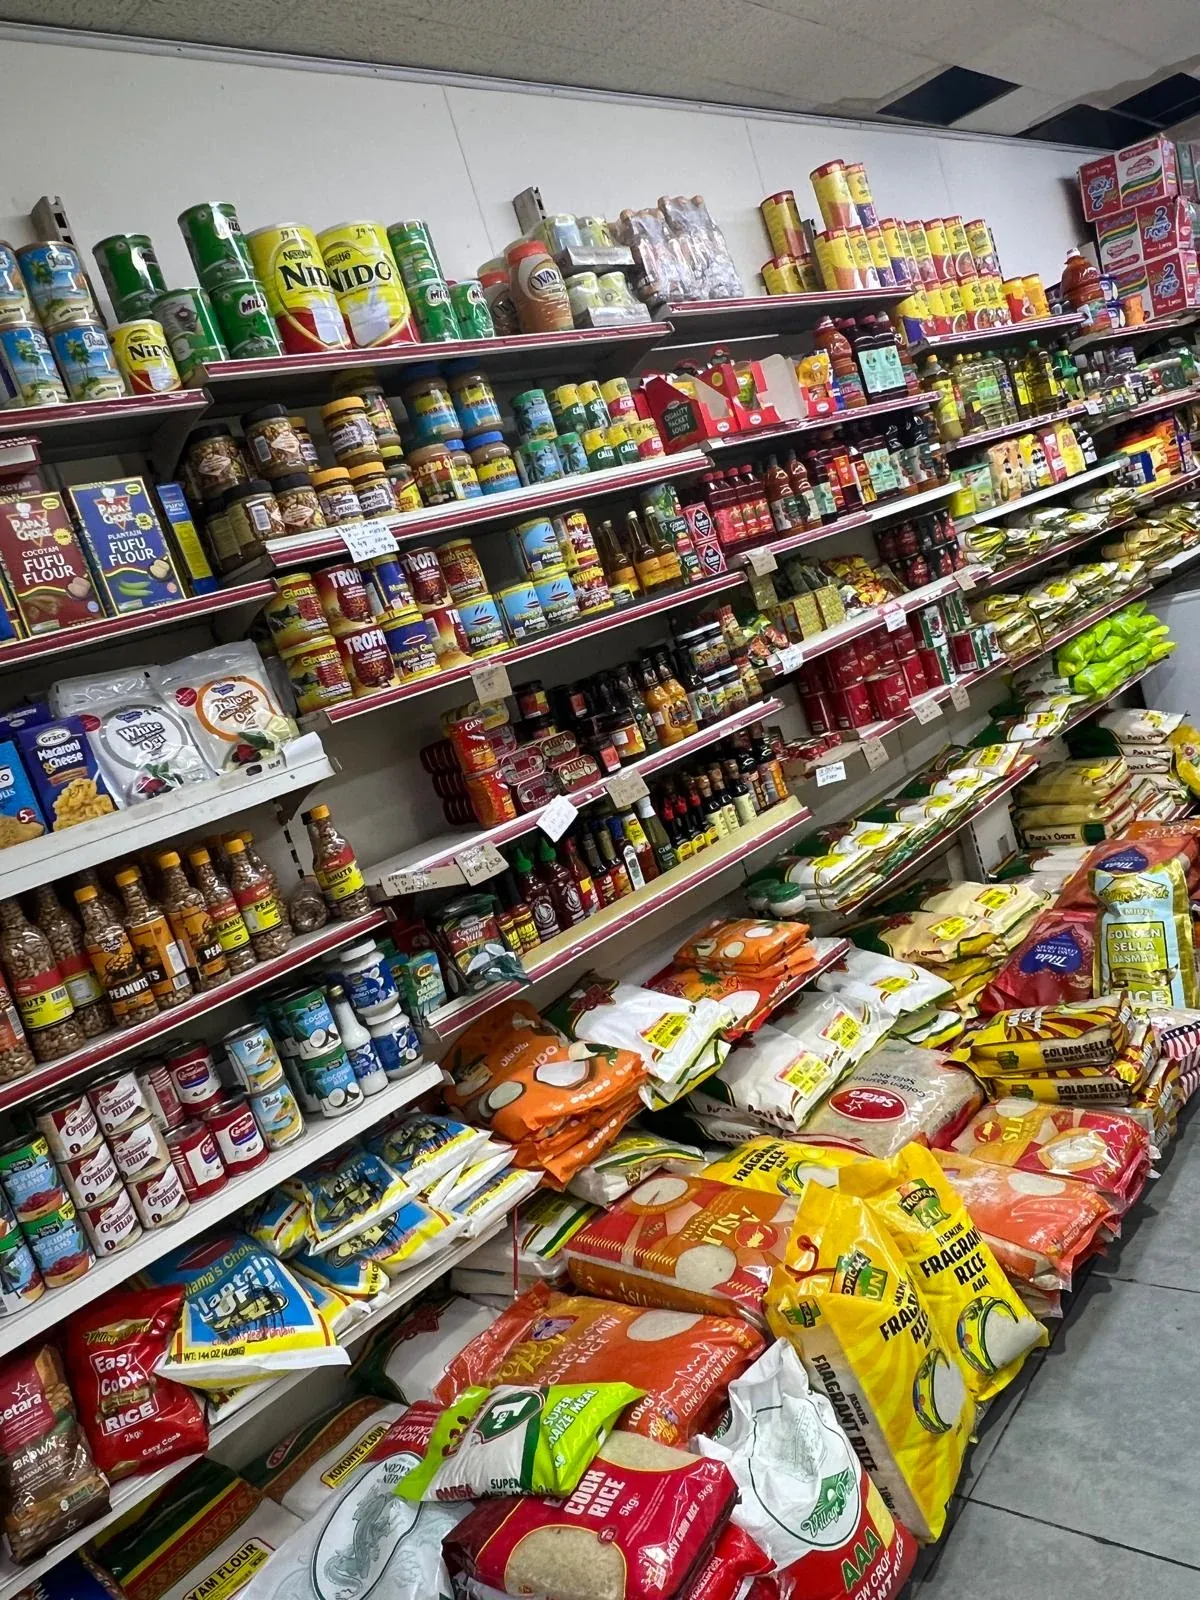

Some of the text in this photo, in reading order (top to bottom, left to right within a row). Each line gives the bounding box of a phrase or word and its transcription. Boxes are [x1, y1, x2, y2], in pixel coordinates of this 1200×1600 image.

[1156, 206, 1167, 222] 2
[1145, 221, 1171, 241] Free
[329, 261, 391, 292] NIDO
[1164, 263, 1175, 278] 2
[1155, 278, 1180, 297] Free
[664, 406, 688, 424] QUALITY
[97, 503, 132, 517] PAPA'S
[10, 517, 49, 533] PAPA'S
[108, 529, 143, 540] PLANTAIN
[109, 537, 147, 554] FUFU
[24, 554, 65, 572] FUFU
[108, 548, 157, 567] FLOUR
[22, 565, 77, 586] FLOUR
[40, 731, 68, 744] Grace
[117, 721, 165, 742] White
[37, 741, 81, 761] Macaroni
[141, 735, 166, 751] Ogi
[50, 751, 84, 768] Cheese
[1029, 833, 1053, 842] PAPA'S
[1113, 941, 1156, 952] SELLA
[1035, 952, 1069, 969] Tilda
[108, 977, 149, 1000] PEANUTS
[1127, 990, 1168, 1004] ICE
[1042, 1044, 1083, 1058] GOLDEN
[848, 1086, 898, 1110] Setara
[1057, 1084, 1098, 1097] GOLDEN
[1097, 1082, 1130, 1094] SELLA
[732, 1142, 785, 1182] FRAGRANT
[758, 1150, 786, 1172] RICE
[953, 1251, 988, 1287] RICE
[864, 1272, 886, 1301] UN
[972, 1275, 991, 1293] AAA
[197, 1350, 209, 1361] 144
[209, 1348, 221, 1359] OZ
[547, 1351, 580, 1385] ONG
[578, 1317, 622, 1352] GRAIN
[576, 1337, 610, 1364] RICE
[95, 1353, 133, 1374] Easy
[101, 1369, 145, 1396] Cook
[681, 1345, 739, 1417] LONG GRAIN RICE
[543, 1396, 574, 1427] SUPER
[569, 1388, 600, 1414] MEAL
[628, 1394, 655, 1428] 10kg
[105, 1401, 155, 1433] RICE
[811, 1354, 861, 1432] FRAGRANT
[850, 1436, 878, 1473] RICE
[327, 1425, 388, 1481] KOKONTE FLOUR
[490, 1478, 522, 1490] SUPER
[564, 1471, 606, 1516] COOK
[697, 1483, 714, 1502] 5kg
[588, 1477, 626, 1518] RICE
[619, 1495, 640, 1517] 5kg
[840, 1525, 881, 1594] AAA
[188, 1543, 259, 1600] YAM FLOUR
[855, 1550, 891, 1600] EW CROP
